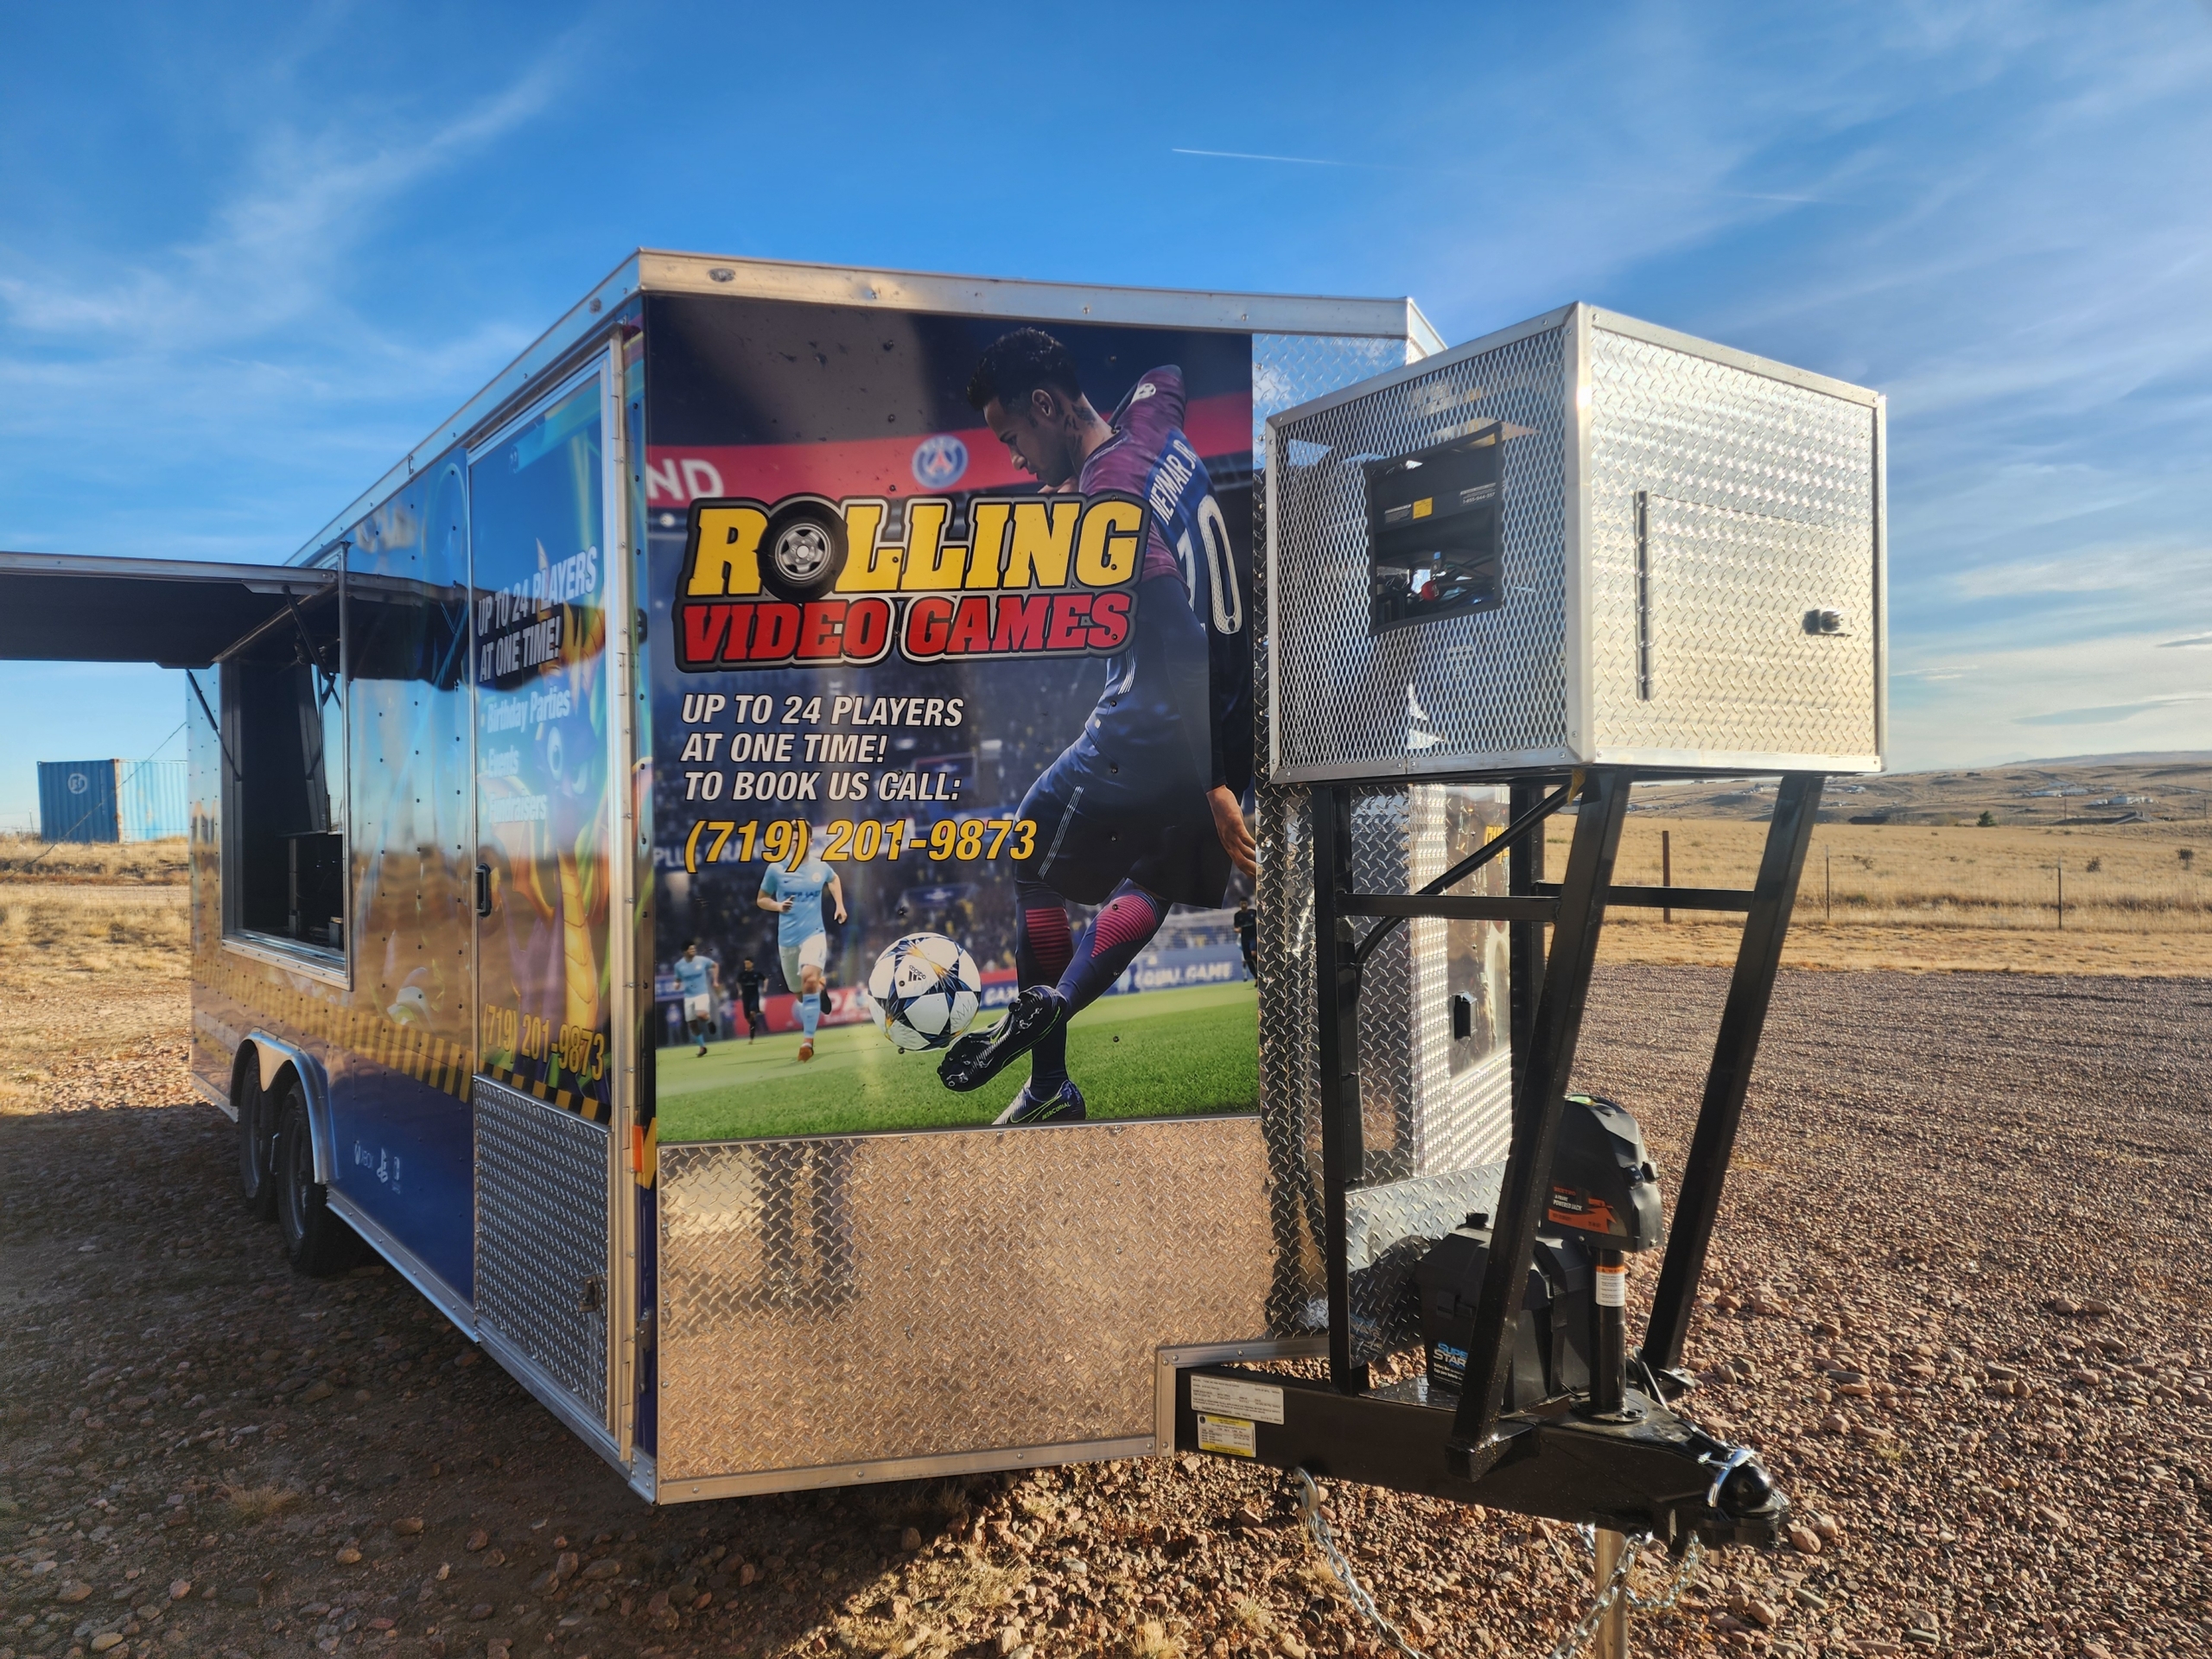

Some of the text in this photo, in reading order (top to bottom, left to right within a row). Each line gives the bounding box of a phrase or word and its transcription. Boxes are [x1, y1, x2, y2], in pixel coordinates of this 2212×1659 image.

[1148, 454, 1193, 525] NEYMAR
[686, 499, 1143, 598] ROLLING
[477, 545, 598, 637] UP TO 24 PLAYERS
[479, 616, 562, 683] AT ONE TIME!
[683, 593, 1133, 662] VIDEO GAMES
[486, 686, 571, 734] Birthday Parties
[681, 693, 964, 727] UP TO 24 PLAYERS
[488, 744, 520, 778] Events
[679, 733, 888, 764] AT ONE TIME!
[684, 771, 962, 802] TO BOOK US CALL:
[683, 818, 1039, 874] (719) 201-9873
[483, 1002, 606, 1081] (719) 201-9873
[1041, 1101, 1072, 1121] MERCURIAL
[1433, 1348, 1467, 1368] STAR
[1437, 1342, 1468, 1360] SUPE
